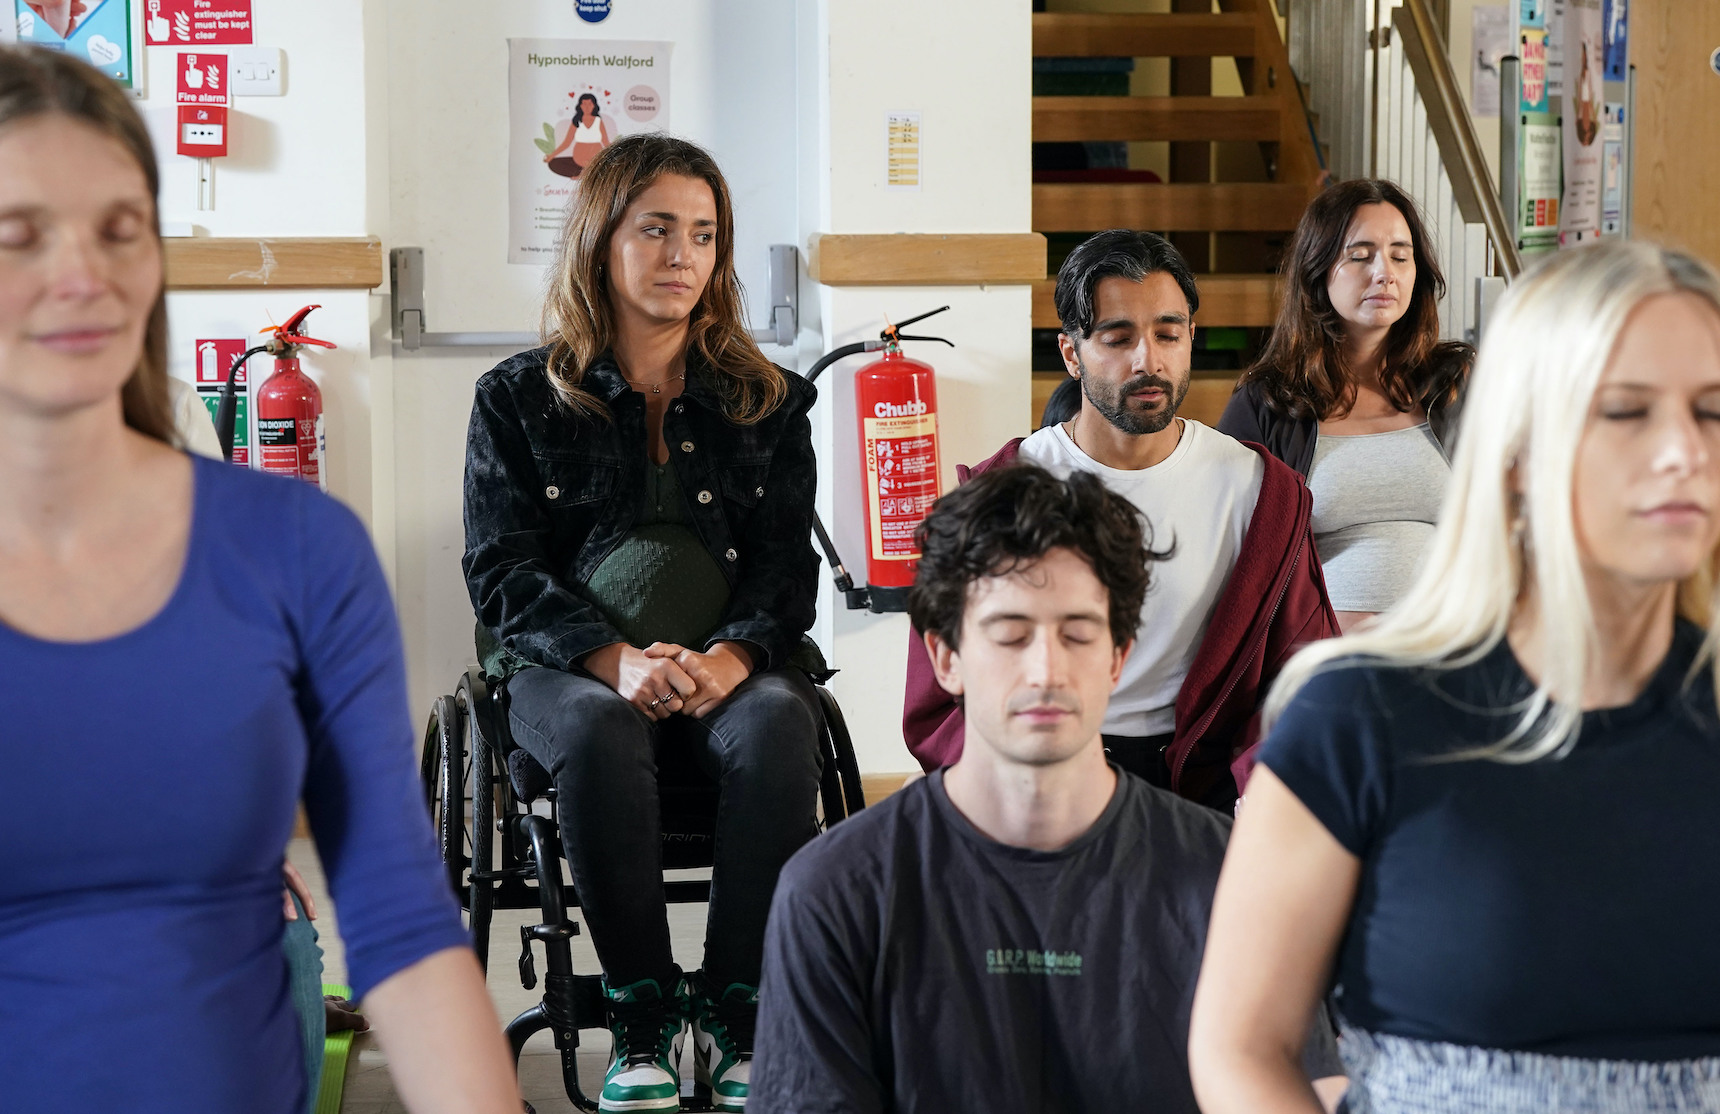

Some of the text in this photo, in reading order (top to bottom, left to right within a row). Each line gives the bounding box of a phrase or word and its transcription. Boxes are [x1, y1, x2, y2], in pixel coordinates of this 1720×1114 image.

[194, 0, 211, 8] Fire
[579, 5, 593, 13] keep
[194, 10, 247, 20] extinguisher
[194, 20, 250, 30] must be kept
[194, 31, 216, 40] clear
[527, 53, 654, 69] Hypnobirth Walford
[178, 92, 226, 103] Fire alarm
[630, 94, 654, 103] Group
[628, 103, 656, 111] classes
[874, 399, 927, 418] Chubb
[268, 420, 294, 429] DIOXIDE
[867, 438, 875, 472] FOAM
[896, 463, 900, 471] 2
[1027, 949, 1083, 967] Worldwide
